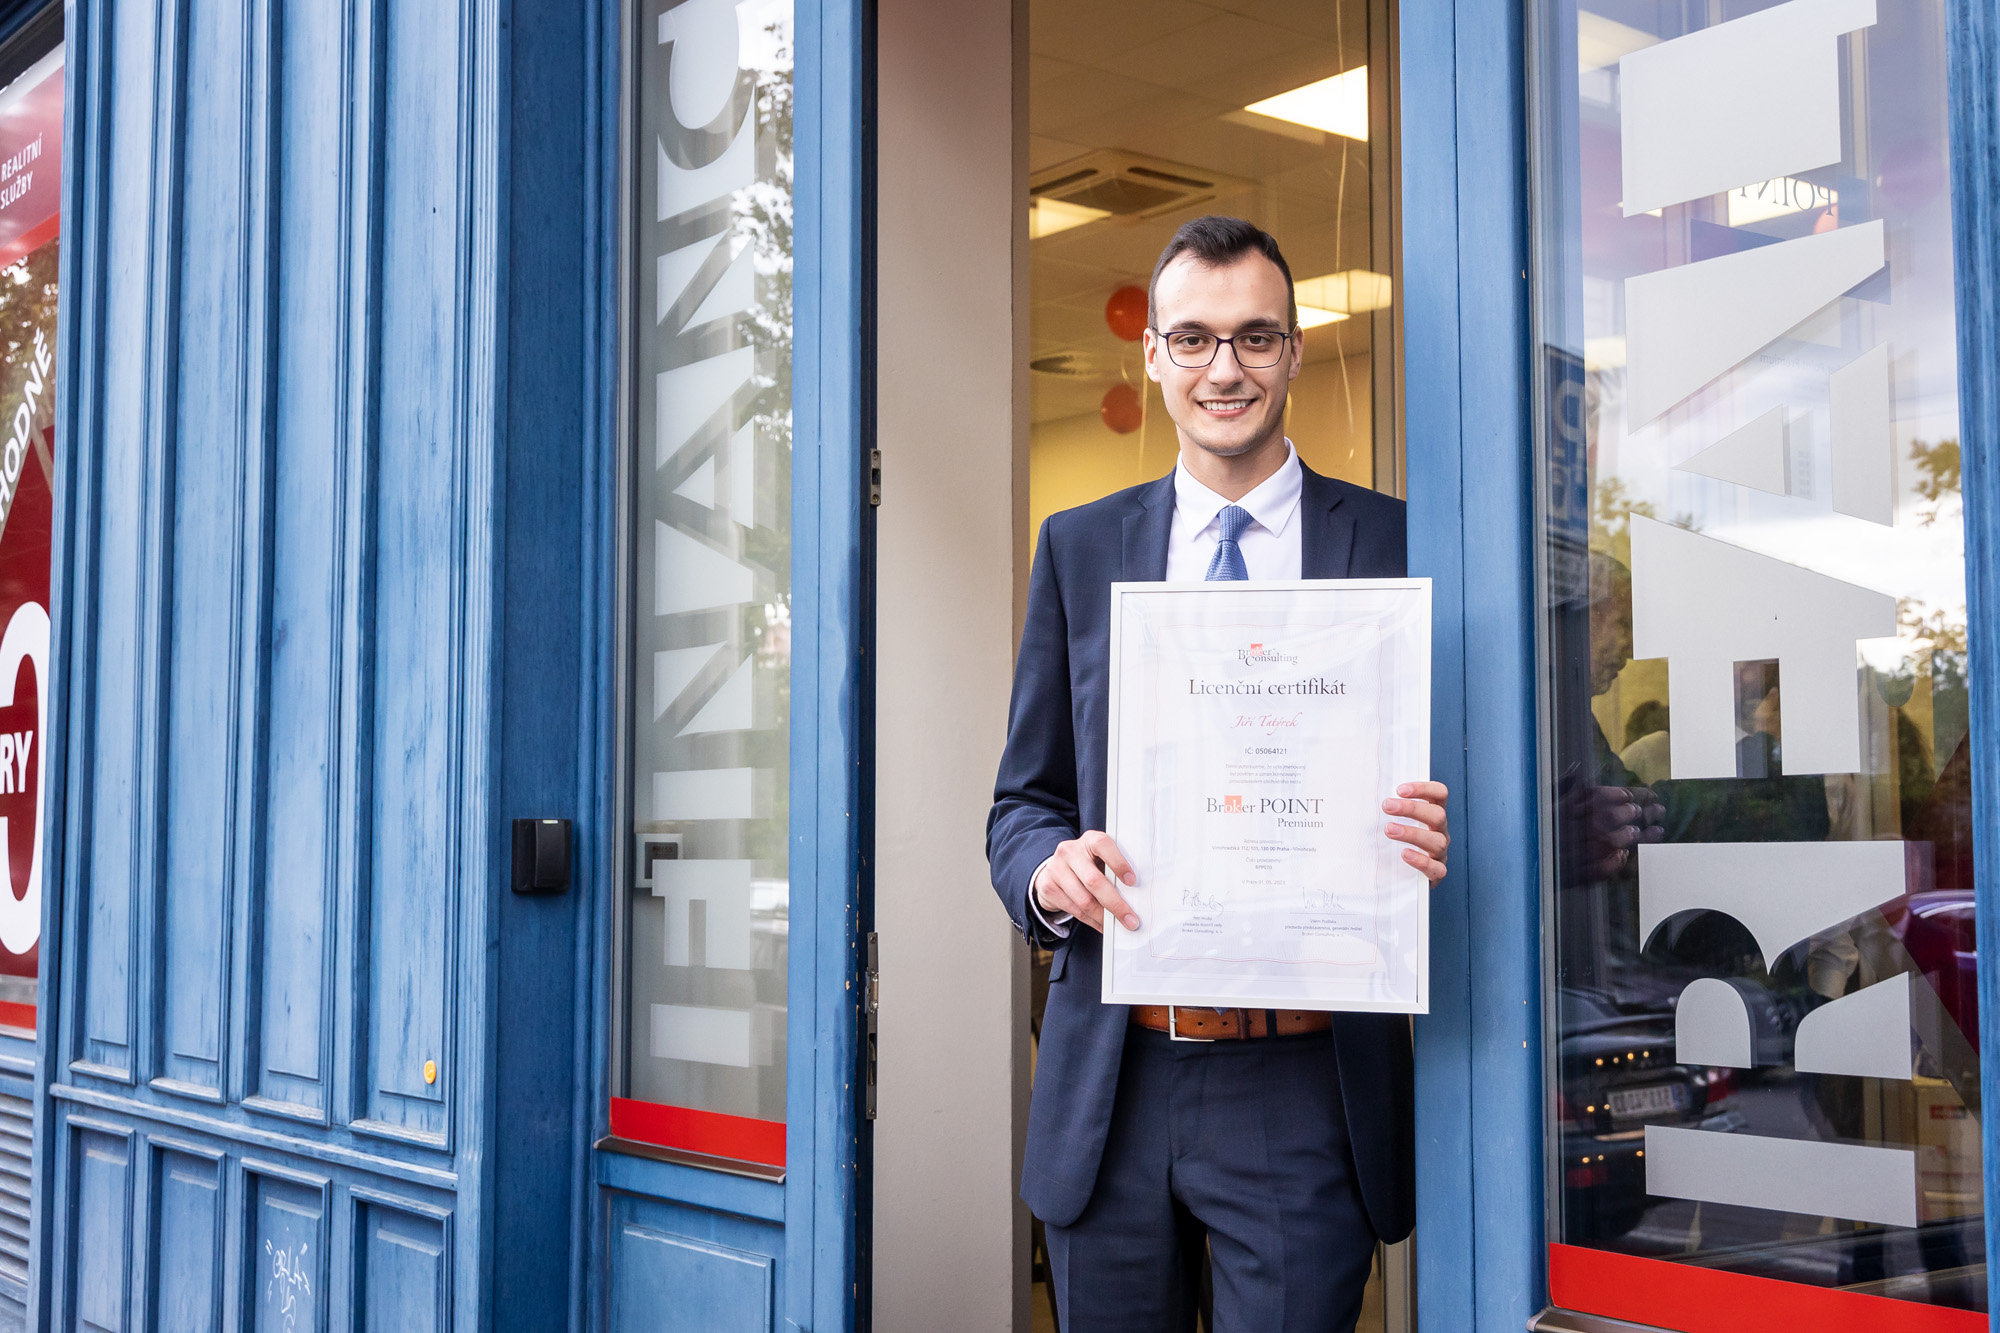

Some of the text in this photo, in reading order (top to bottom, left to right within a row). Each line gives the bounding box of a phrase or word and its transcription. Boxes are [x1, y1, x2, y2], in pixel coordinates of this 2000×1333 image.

[1, 131, 43, 183] REALITNÍ
[0, 170, 34, 210] SLUŽBY
[1238, 645, 1272, 660] Broker
[1245, 652, 1298, 667] Consulting
[1189, 677, 1347, 696] Licenční certifikát
[1231, 714, 1256, 729] Jiří
[1255, 748, 1287, 756] 05064121
[1206, 797, 1324, 814] Broker POINT
[1277, 817, 1324, 829] Premium
